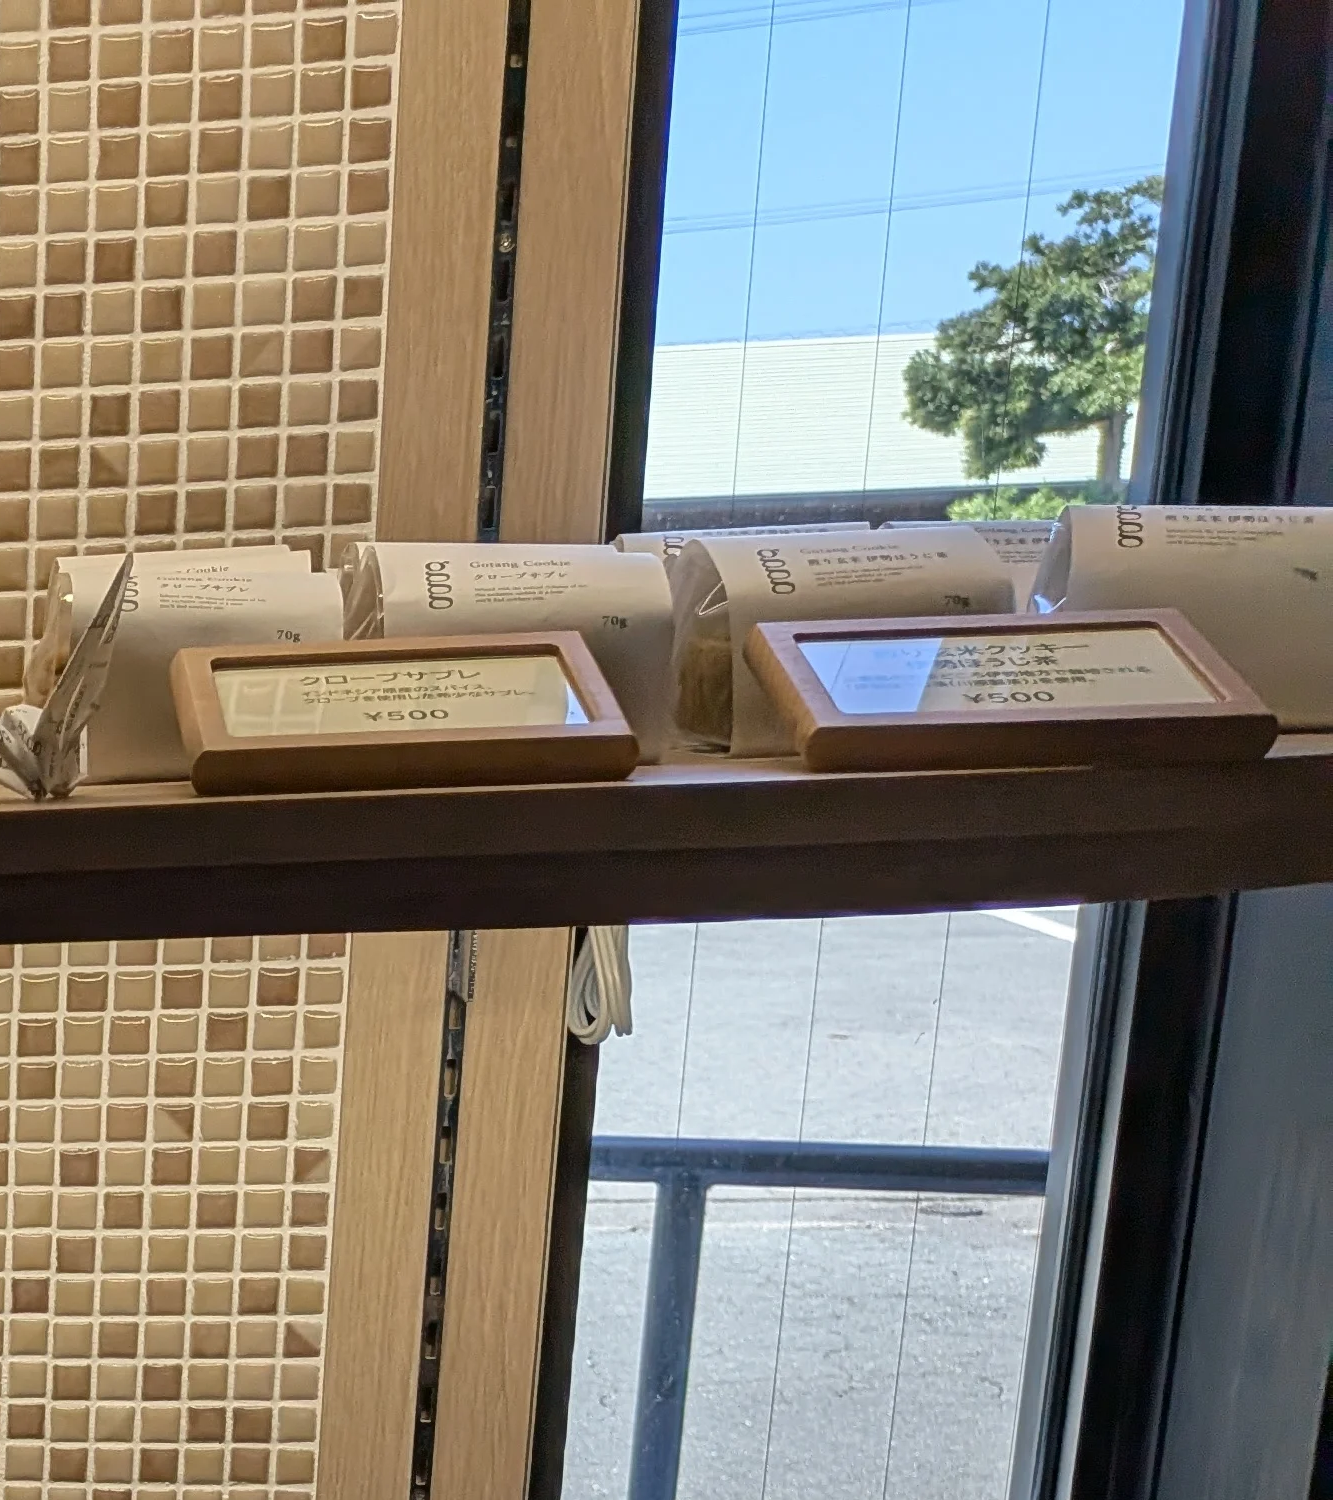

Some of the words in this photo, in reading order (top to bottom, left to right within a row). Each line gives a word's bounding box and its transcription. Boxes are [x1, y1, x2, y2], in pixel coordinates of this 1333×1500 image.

[276, 629, 301, 643] 70g
[300, 669, 480, 686] クローブサブレ
[962, 691, 1055, 704] ¥500
[364, 710, 449, 722] ¥500
